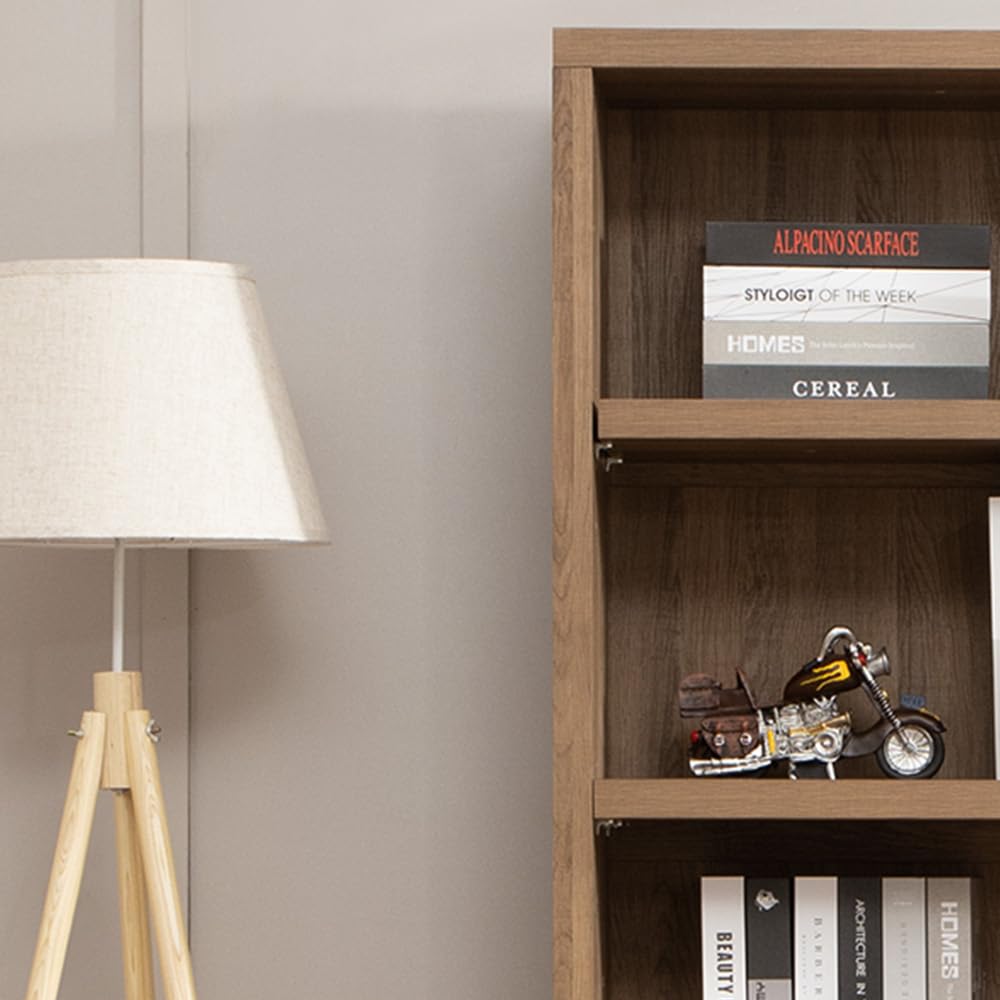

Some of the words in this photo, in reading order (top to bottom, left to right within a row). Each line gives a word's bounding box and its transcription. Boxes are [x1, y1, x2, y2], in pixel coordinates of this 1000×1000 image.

[773, 229, 846, 256] ALPACINO
[847, 230, 920, 257] SCARFACE
[744, 288, 815, 302] STYLOIGT
[819, 289, 841, 302] OF
[846, 290, 871, 302] THE
[874, 290, 917, 303] WEEK
[727, 335, 806, 354] HOMES
[792, 380, 896, 398] CEREAL
[855, 898, 868, 977] ARCHITECTURE
[940, 902, 960, 980] HOMES
[716, 931, 735, 995] BEAUTY
[856, 981, 868, 996] IN
